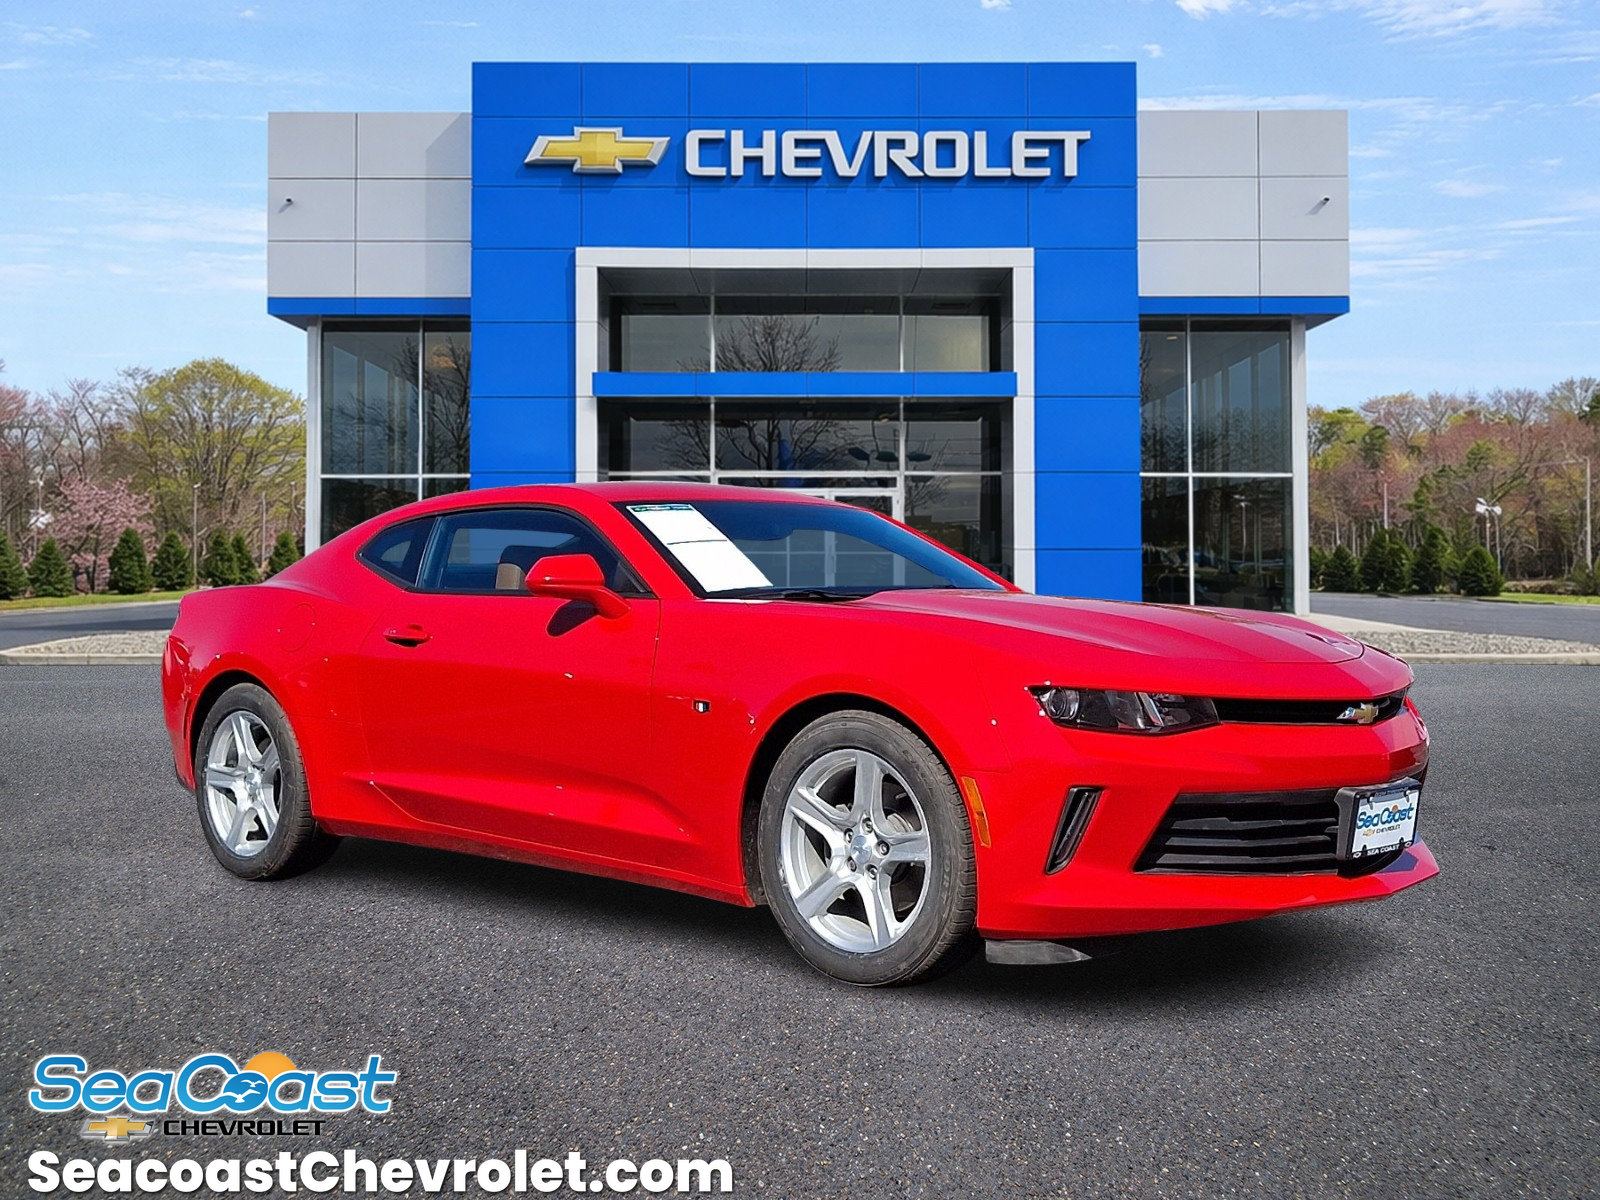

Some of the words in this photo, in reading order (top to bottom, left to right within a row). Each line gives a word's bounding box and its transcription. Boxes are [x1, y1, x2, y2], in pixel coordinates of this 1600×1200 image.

[685, 129, 1092, 178] CHEVROLET
[1366, 848, 1380, 856] SEA
[1380, 844, 1400, 853] COAST
